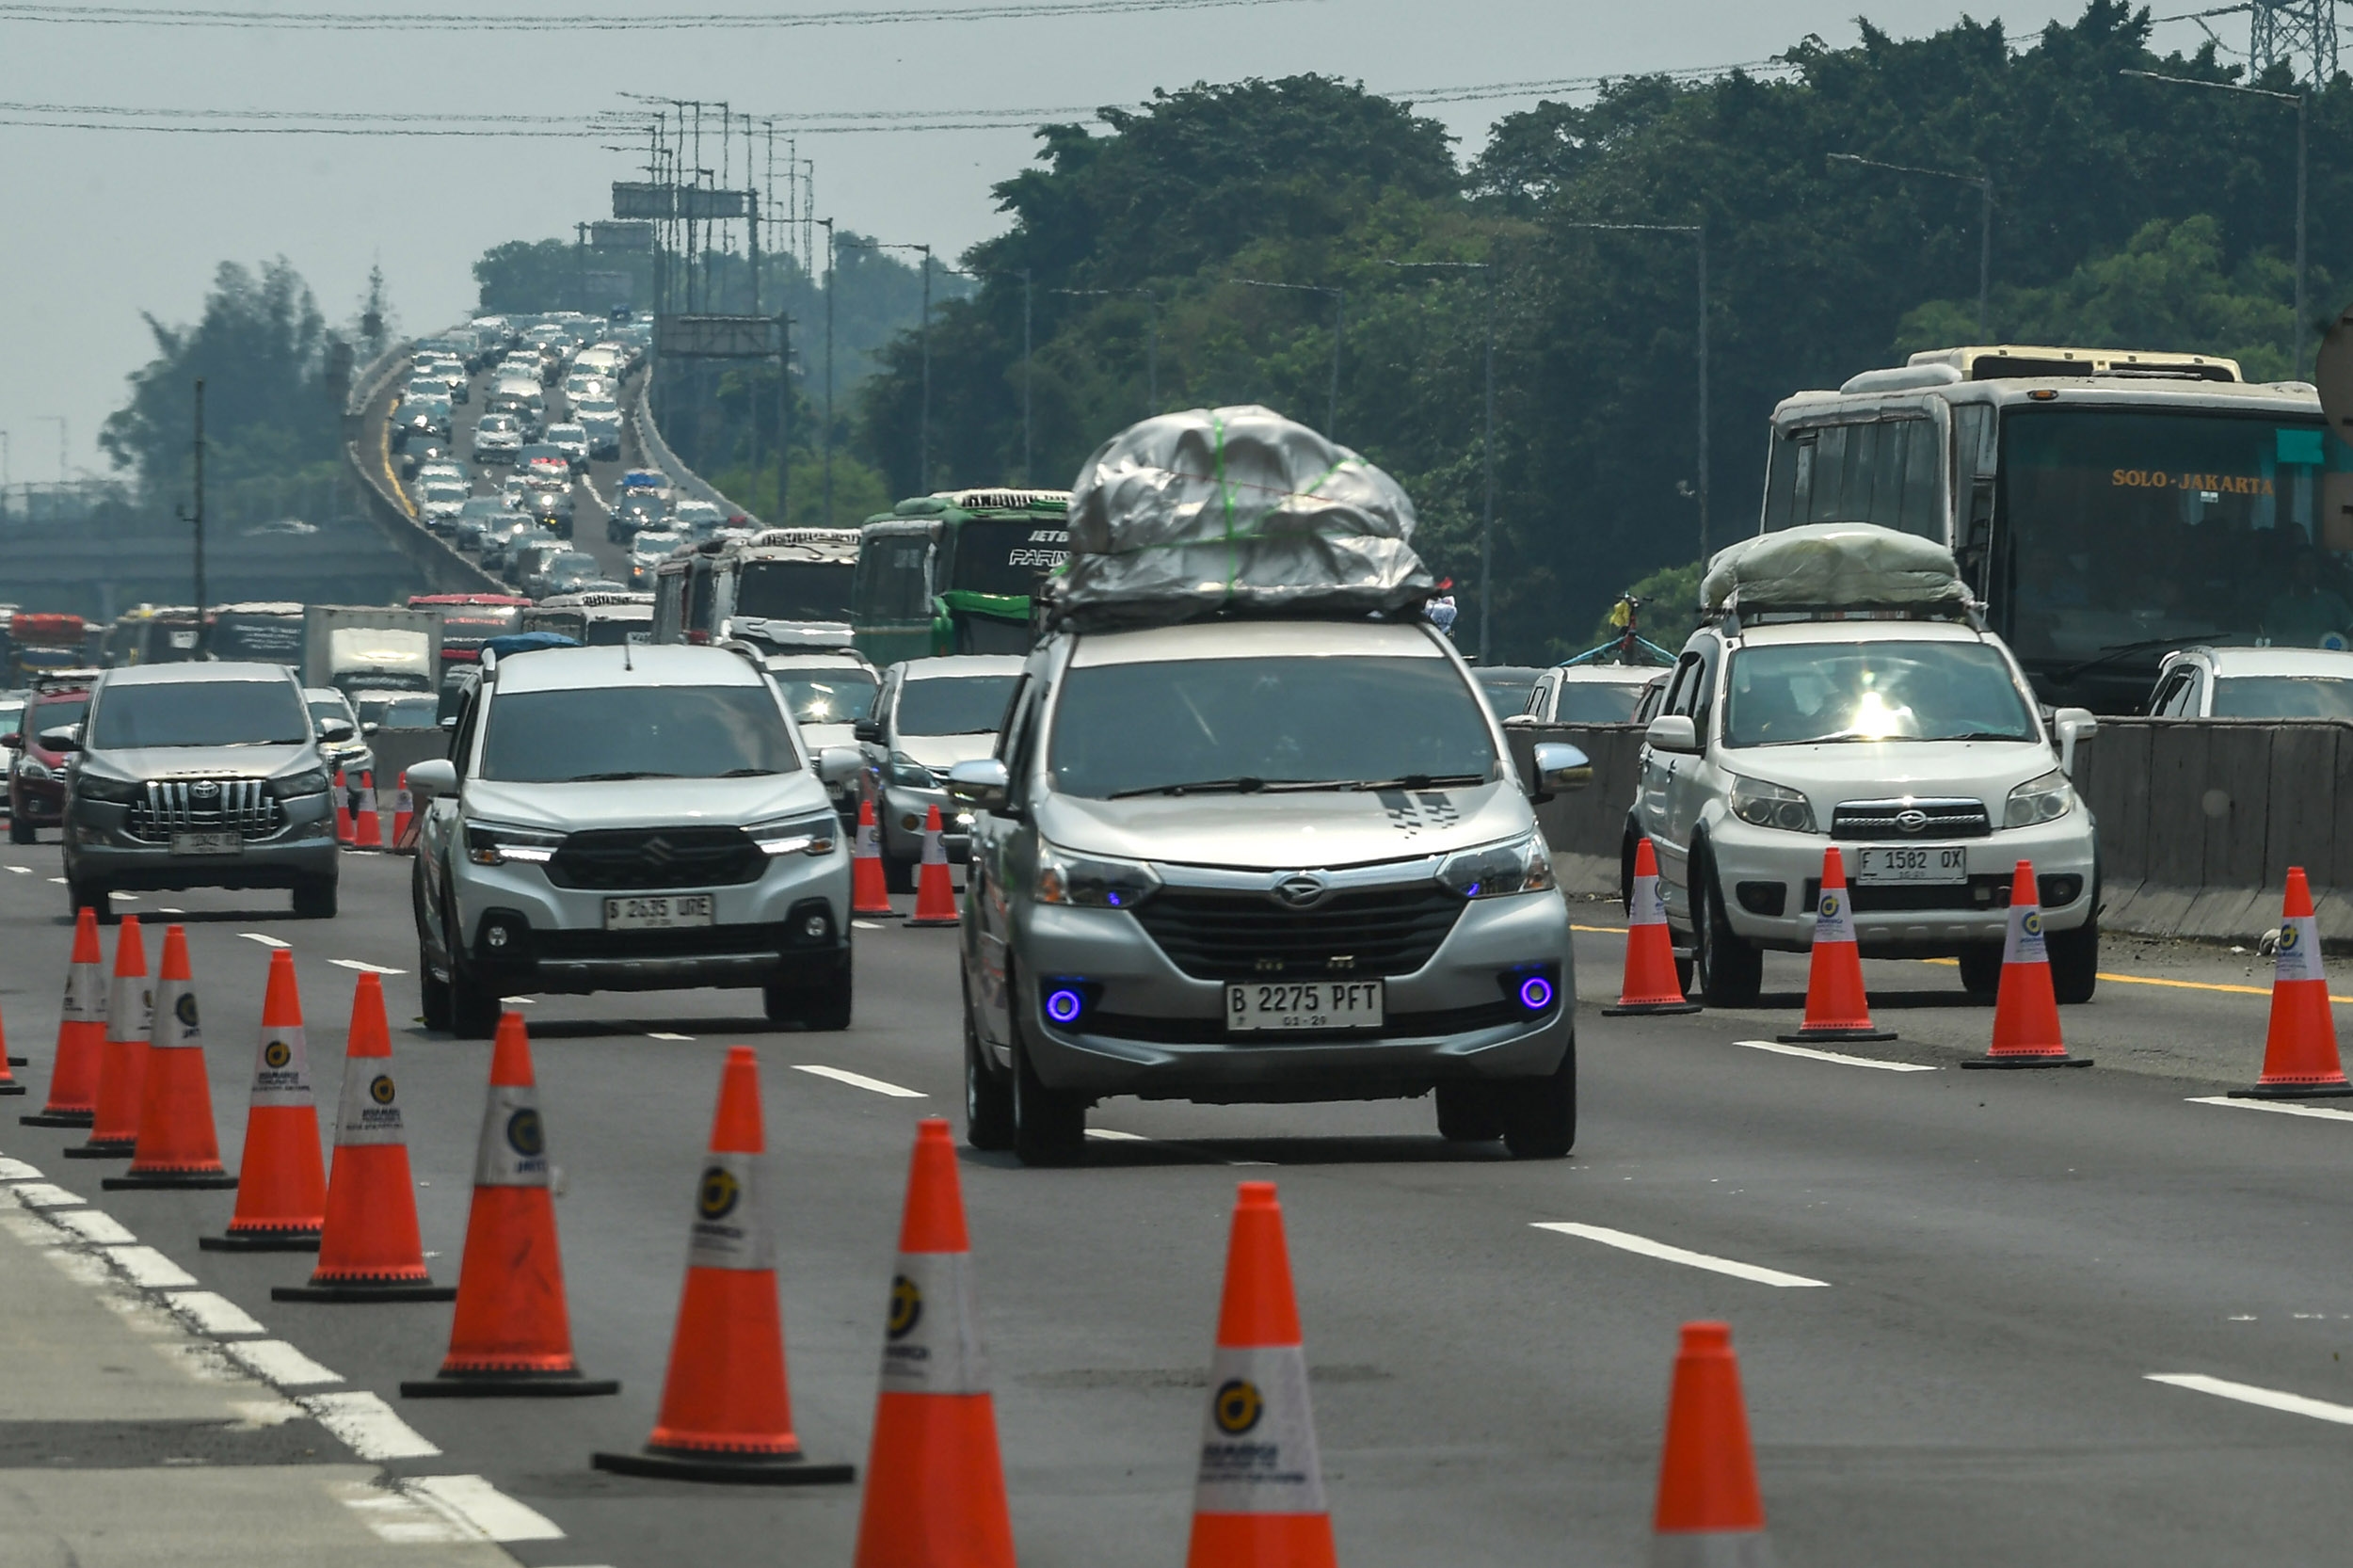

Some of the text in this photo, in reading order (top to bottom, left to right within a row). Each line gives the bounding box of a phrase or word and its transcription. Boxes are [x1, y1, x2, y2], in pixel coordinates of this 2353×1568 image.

[2112, 469, 2167, 488] SOLO
[2178, 473, 2275, 496] JAKARTA
[1863, 851, 1871, 869] F
[1884, 851, 1928, 869] 1582
[1232, 984, 1377, 1013] B 2275 PFT
